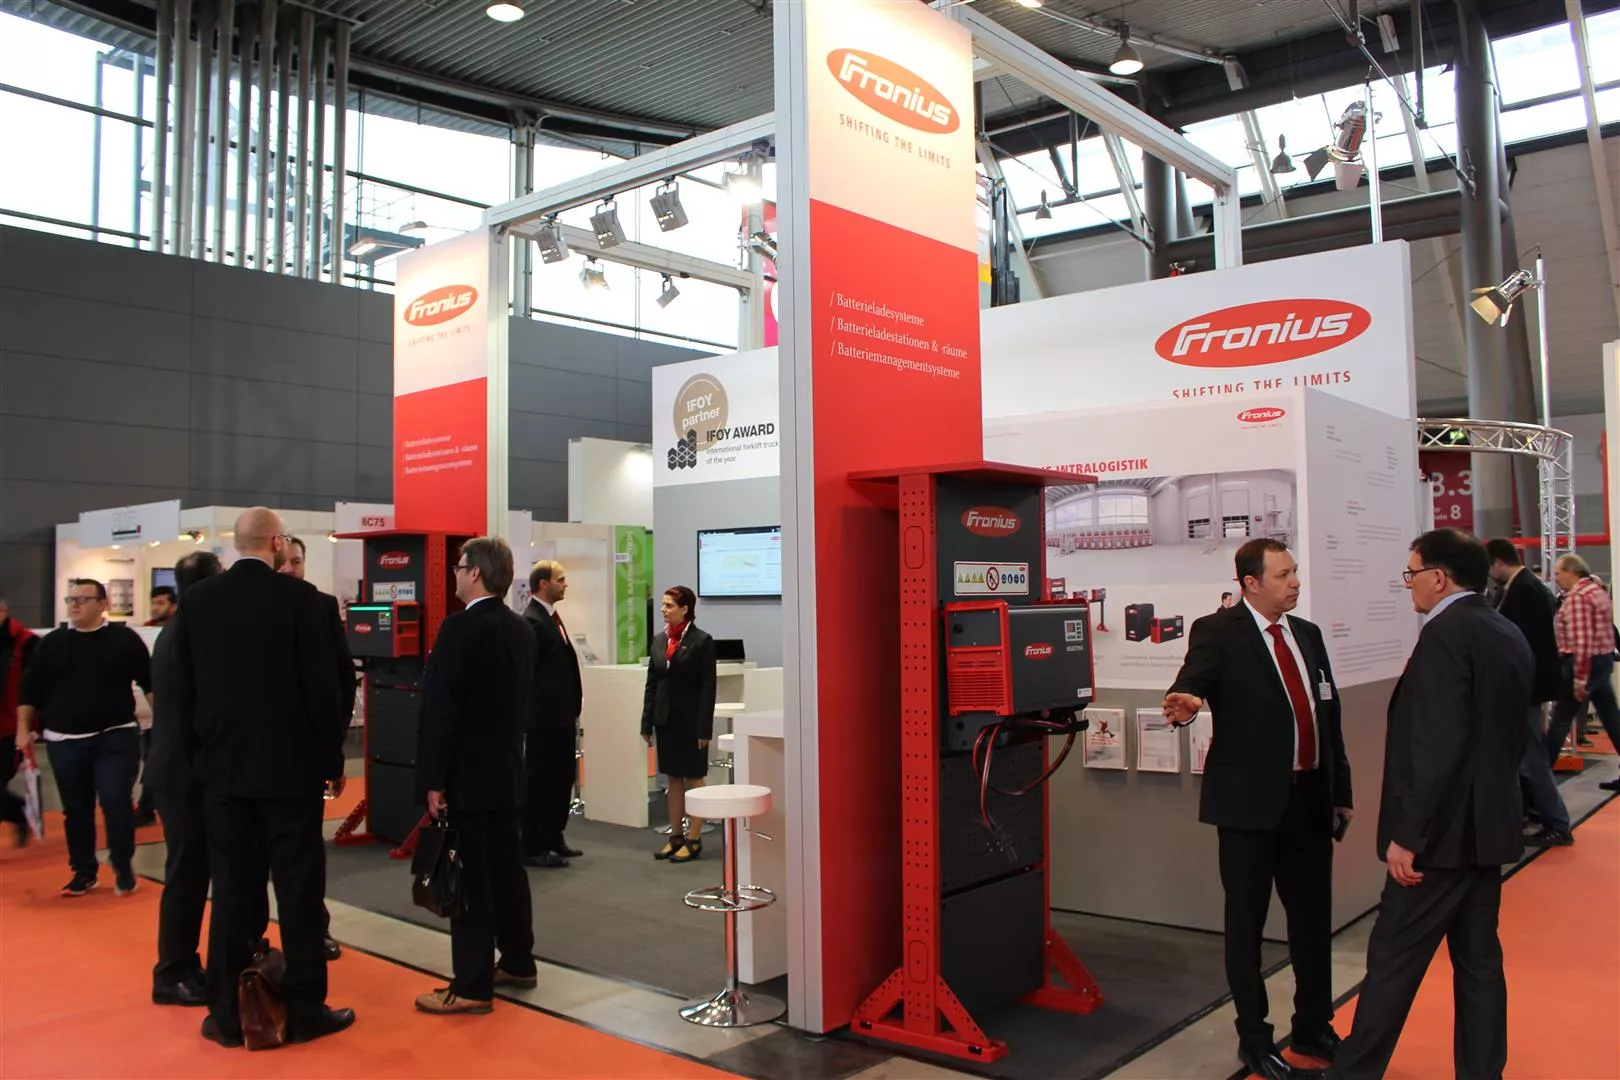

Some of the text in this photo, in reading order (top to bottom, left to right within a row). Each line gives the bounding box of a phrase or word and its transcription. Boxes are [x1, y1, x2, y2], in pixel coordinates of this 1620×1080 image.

[839, 53, 952, 126] Fronius
[839, 113, 951, 169] SHIFTING THE LIMITS
[407, 290, 473, 321] Fronius
[836, 293, 925, 326] Batterieladesysteme
[837, 317, 930, 350] Batterieladestationen
[931, 340, 938, 353] &
[1171, 312, 1353, 357] Fronius
[837, 342, 960, 379] Batteriemanagementsysteme
[1172, 382, 1245, 399] SHIFTING
[686, 393, 713, 413] IFOY
[681, 406, 721, 430] partner
[706, 423, 775, 442] IFOY AWARD
[361, 517, 385, 527] 8C75
[966, 511, 1016, 529] Fronius
[1450, 504, 1461, 520] 8
[1025, 645, 1053, 656] Fronius
